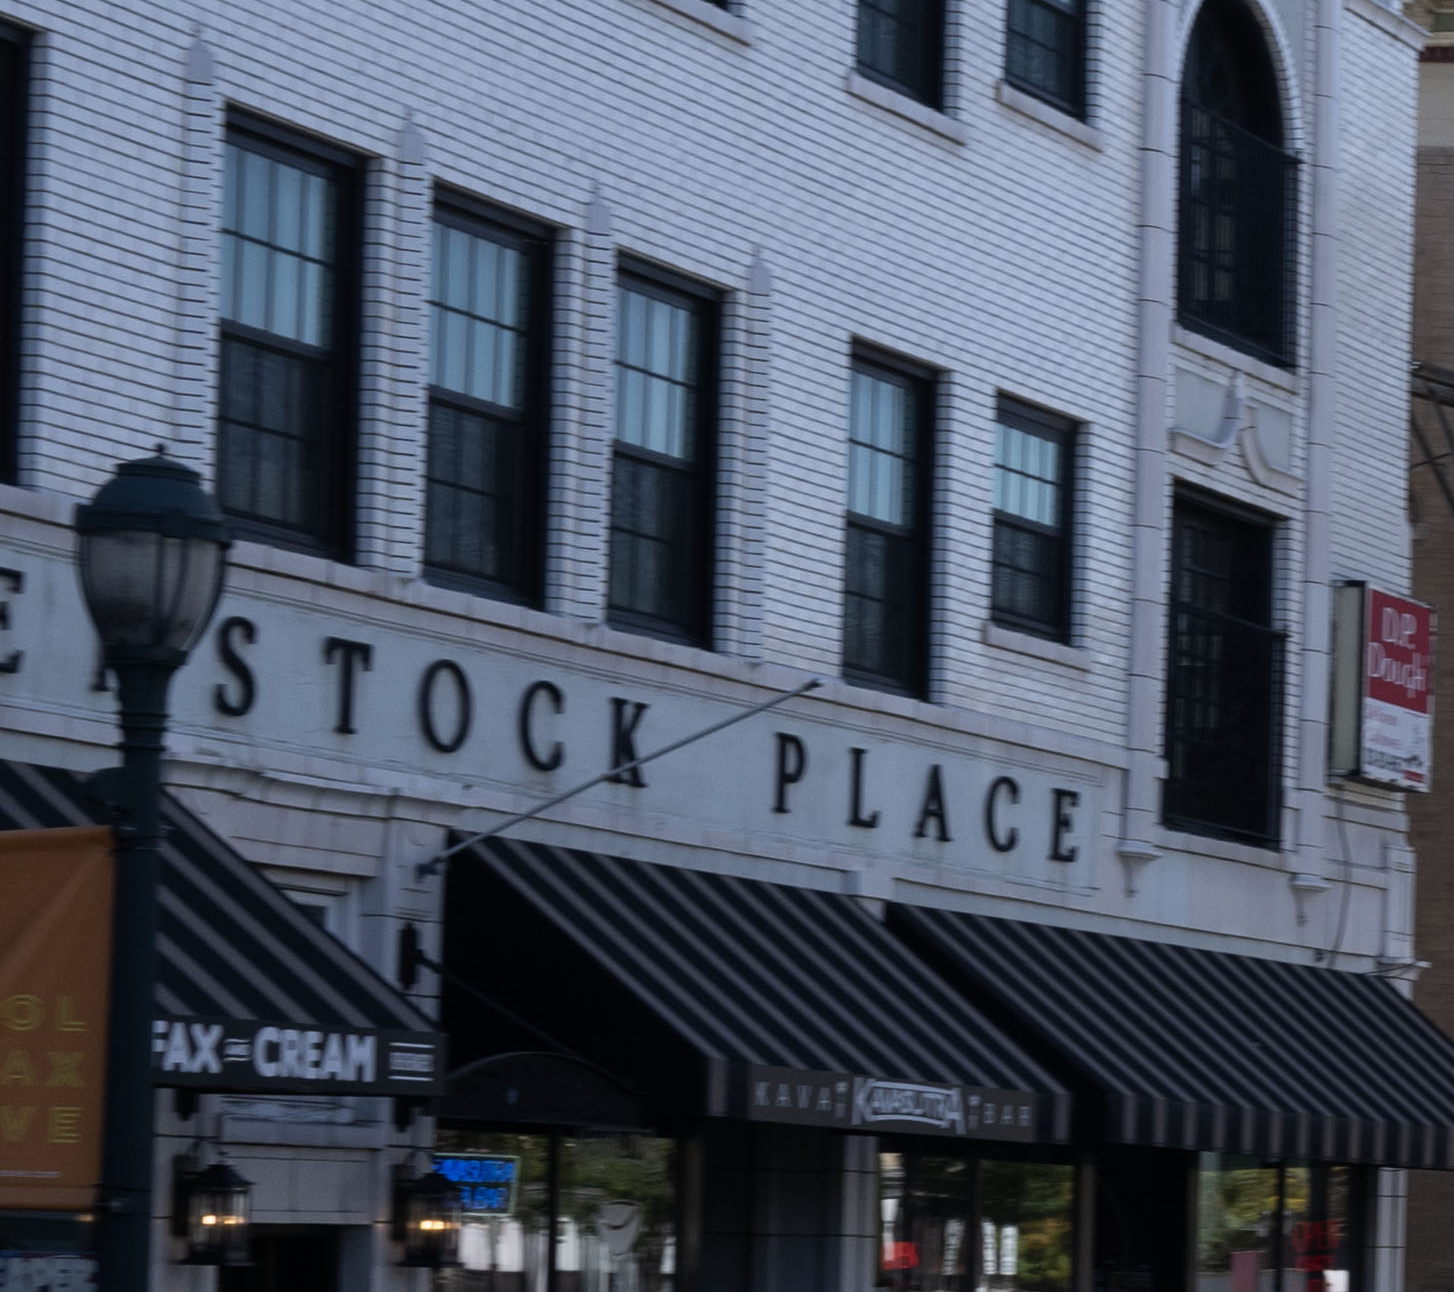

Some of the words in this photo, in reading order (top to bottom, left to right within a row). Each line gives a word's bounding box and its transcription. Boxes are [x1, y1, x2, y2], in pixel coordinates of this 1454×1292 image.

[1367, 641, 1427, 699] Dough
[771, 731, 1080, 862] PLACE
[253, 1026, 377, 1082] CREAM
[754, 1080, 833, 1112] KAVA
[983, 1103, 1032, 1128] BAR
